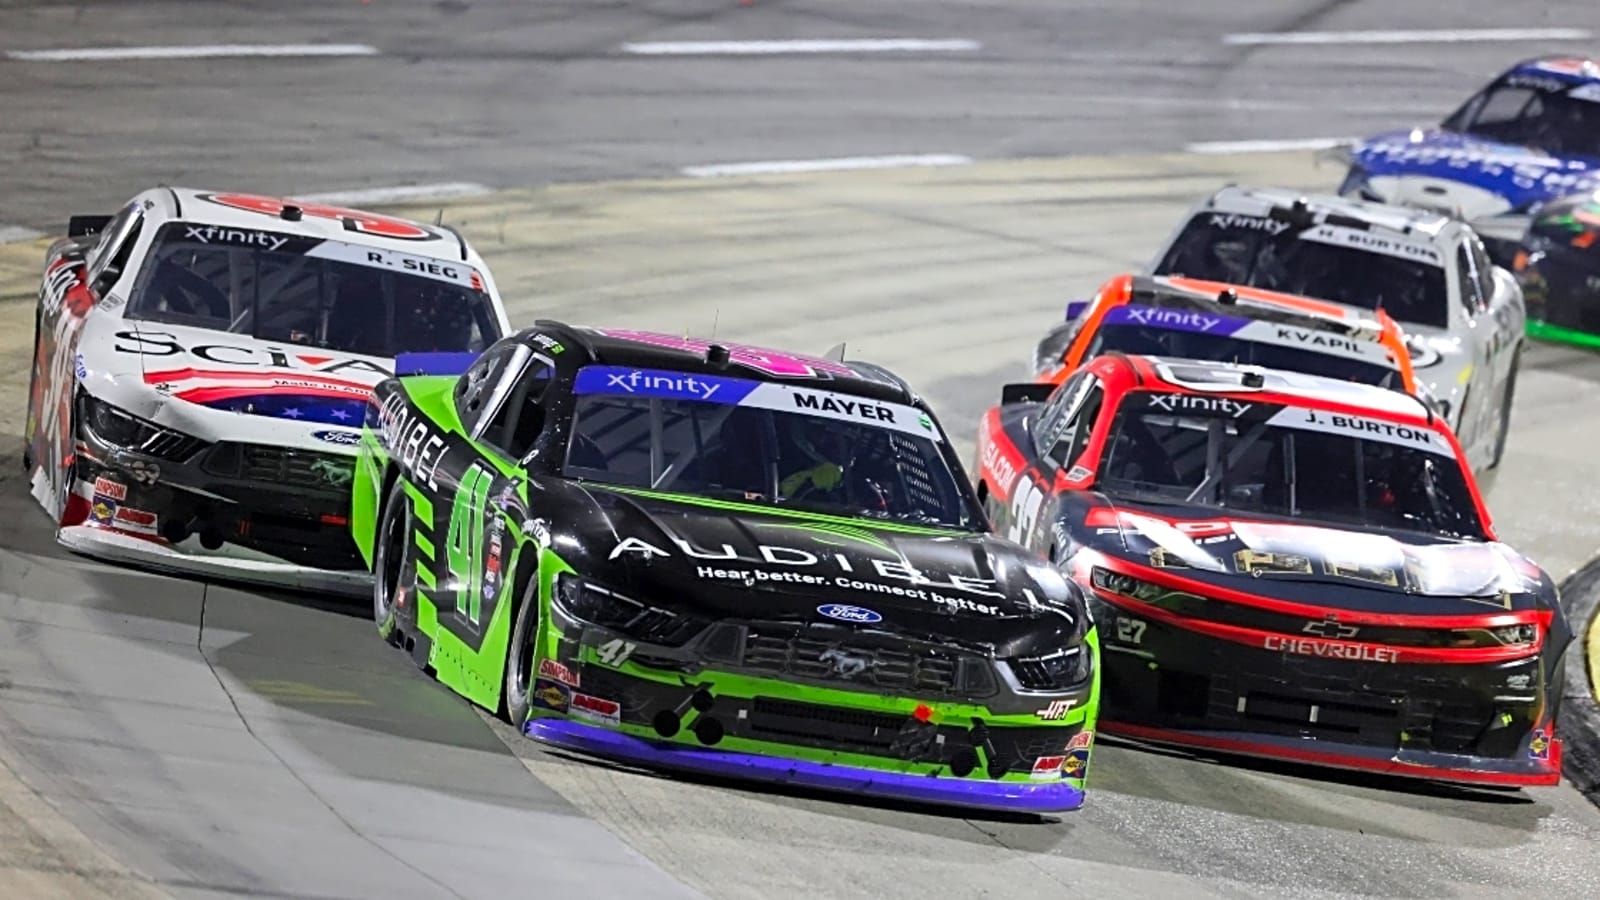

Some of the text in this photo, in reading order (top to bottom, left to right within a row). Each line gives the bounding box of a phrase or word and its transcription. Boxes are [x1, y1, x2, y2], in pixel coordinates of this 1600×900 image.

[1208, 211, 1291, 235] xfinity
[184, 225, 288, 251] xfinity
[1347, 232, 1439, 262] BURTON
[368, 251, 459, 280] R. SIEG
[1126, 306, 1220, 330] xfinity
[1276, 327, 1366, 355] KVAPIL
[607, 371, 721, 400] xfinity
[791, 392, 897, 424] MAYER
[1149, 392, 1253, 418] xfinity
[1305, 410, 1431, 444] J. BURTON
[446, 460, 495, 628] 41
[608, 535, 1074, 624] AUDIBEL
[697, 566, 1005, 617] Hear better. Connect better.
[829, 605, 871, 621] Ford
[1116, 616, 1147, 644] 27
[596, 638, 637, 667] 41
[1264, 635, 1400, 664] CHEVROLET
